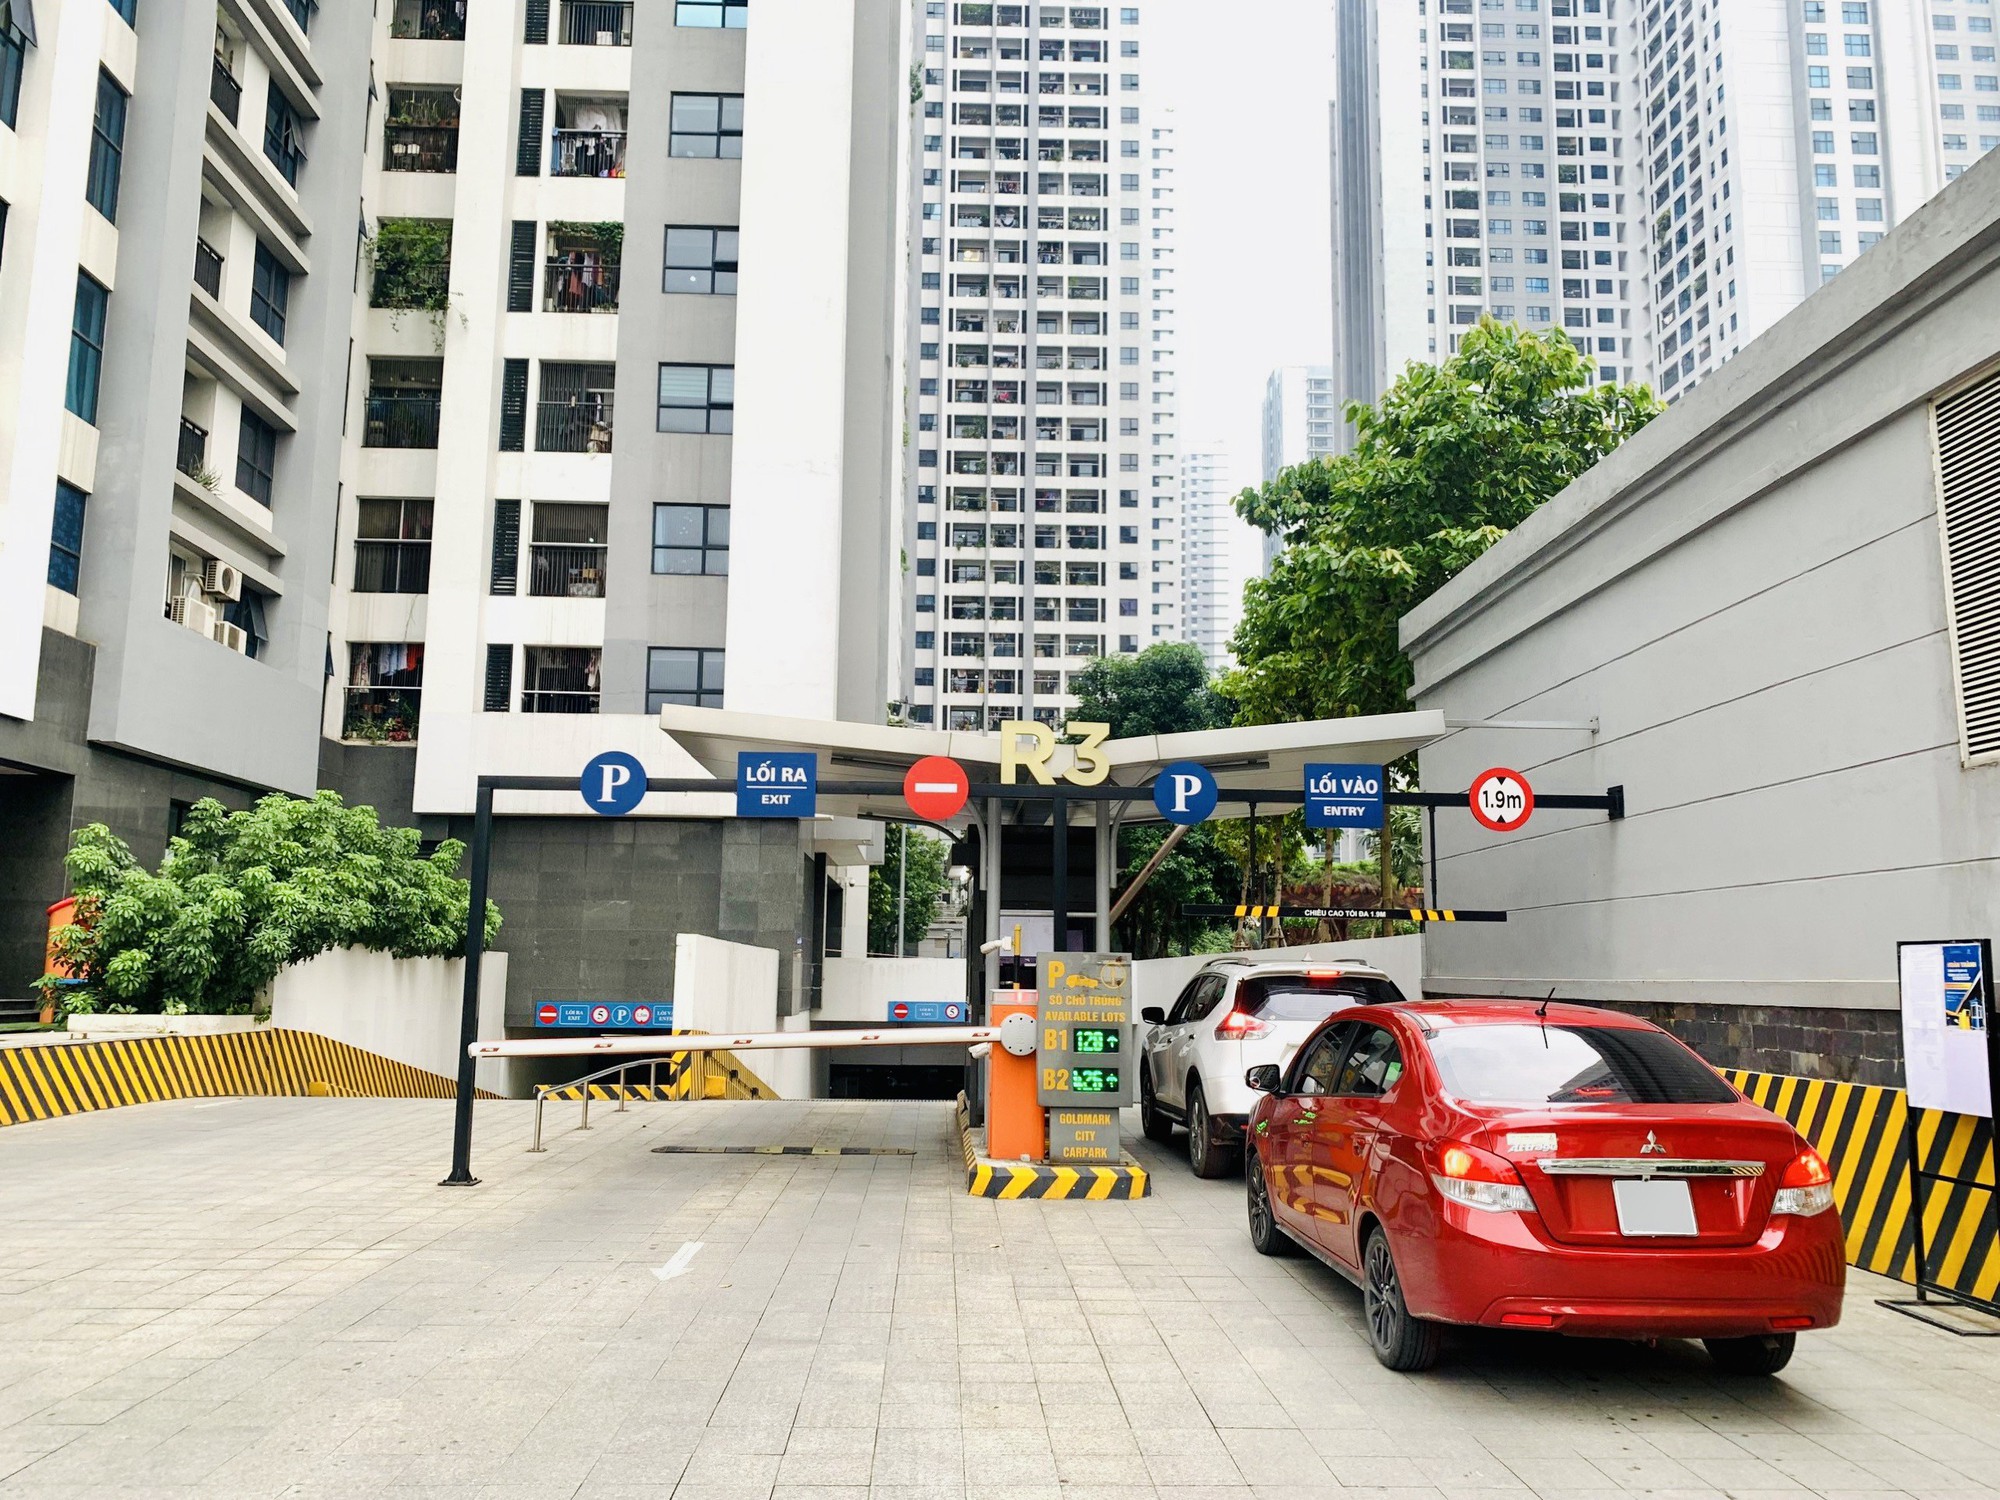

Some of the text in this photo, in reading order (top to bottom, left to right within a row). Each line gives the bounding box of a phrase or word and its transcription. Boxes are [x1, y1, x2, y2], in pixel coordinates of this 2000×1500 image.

[1001, 720, 1110, 786] R3
[746, 761, 808, 782] LỐI RA
[597, 765, 631, 802] P
[1310, 772, 1378, 795] LỐI VÀO
[1171, 774, 1202, 812] P
[761, 794, 791, 805] EXIT
[1482, 790, 1522, 809] 1.9m
[1323, 806, 1365, 817] ENTRY
[1327, 909, 1345, 917] CAO
[1370, 910, 1387, 918] 1.9M
[1048, 960, 1066, 989] P
[597, 1010, 604, 1020] 5
[617, 1009, 627, 1021] P
[949, 1008, 955, 1016] 5
[1045, 1011, 1126, 1022] AVAILABLE LOTS
[1044, 1028, 1068, 1051] B1
[1043, 1068, 1069, 1091] B2
[1059, 1113, 1111, 1125] GOLDMARK
[1075, 1130, 1096, 1142] CITY
[1063, 1146, 1108, 1158] CARPARK
